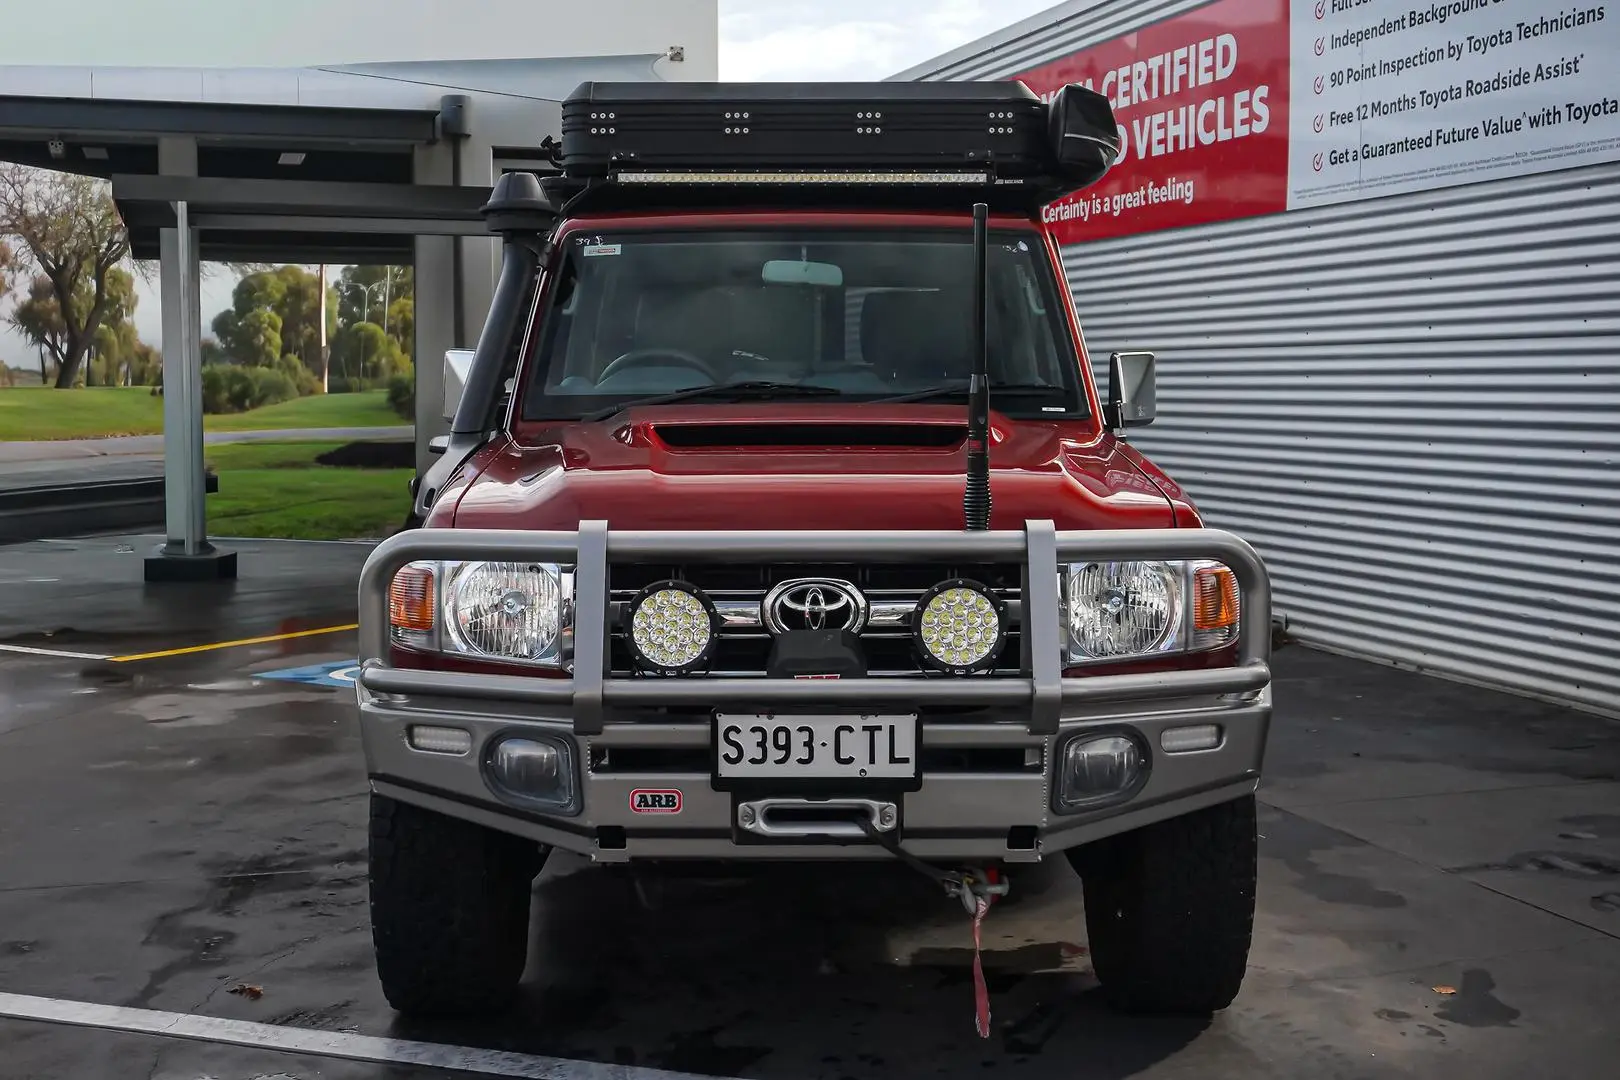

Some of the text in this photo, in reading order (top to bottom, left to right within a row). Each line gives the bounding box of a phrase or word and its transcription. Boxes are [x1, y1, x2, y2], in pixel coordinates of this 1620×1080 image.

[1330, 6, 1605, 88] 90 Point Inspection by Toyota Technicians
[1331, 14, 1406, 50] Independent
[1101, 33, 1238, 111] CERTIFIED
[1330, 111, 1354, 127] Free
[1356, 104, 1369, 121] 12
[1371, 93, 1417, 118] Months
[1419, 85, 1462, 109] Toyota
[1465, 67, 1531, 98] Roadside
[1132, 85, 1270, 160] VEHICLES
[1329, 148, 1350, 166] Get
[1352, 150, 1359, 161] a
[1361, 130, 1433, 160] Guaranteed
[1436, 126, 1479, 146] Future
[1528, 105, 1562, 129] with
[1565, 97, 1619, 124] Toyota
[1042, 177, 1194, 223] Certainty is a great feeling
[636, 794, 678, 808] ARB
